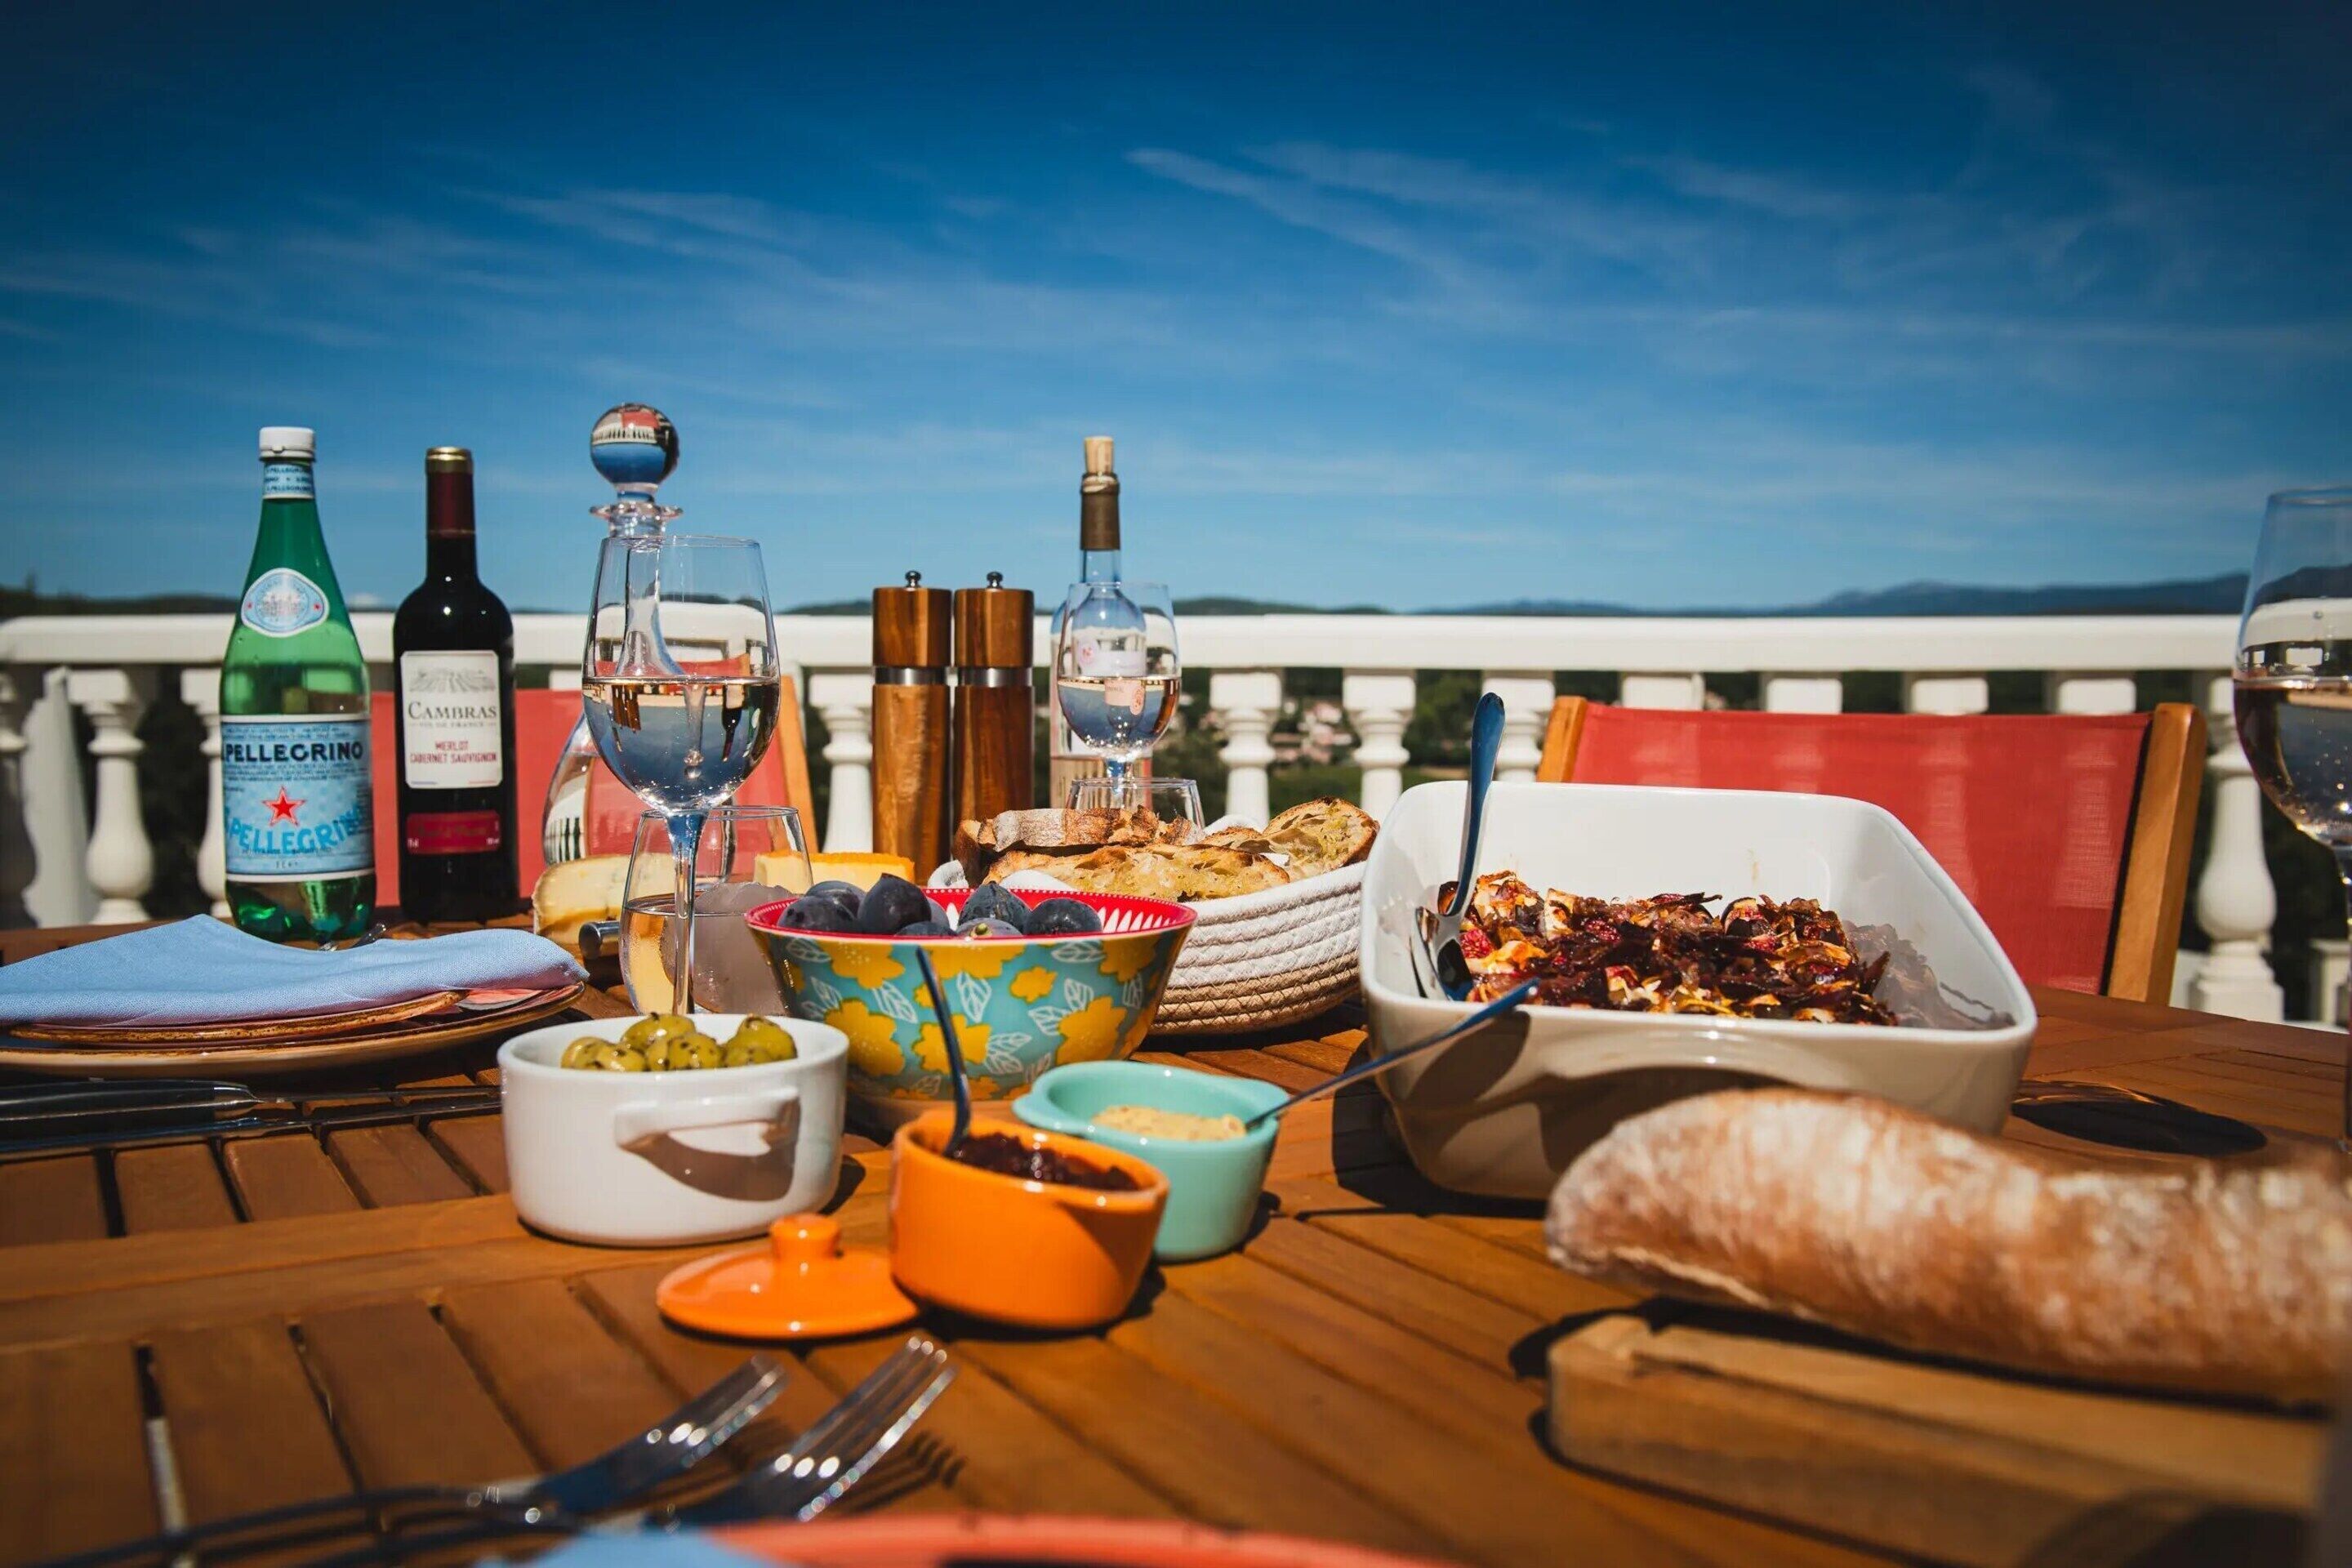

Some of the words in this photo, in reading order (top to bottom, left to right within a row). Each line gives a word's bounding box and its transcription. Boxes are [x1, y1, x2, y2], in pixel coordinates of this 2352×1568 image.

[408, 701, 497, 720] CAMBRAS
[434, 740, 469, 751] MERLOT
[410, 751, 448, 764] CABERNET
[451, 751, 497, 764] SAUVIGNON
